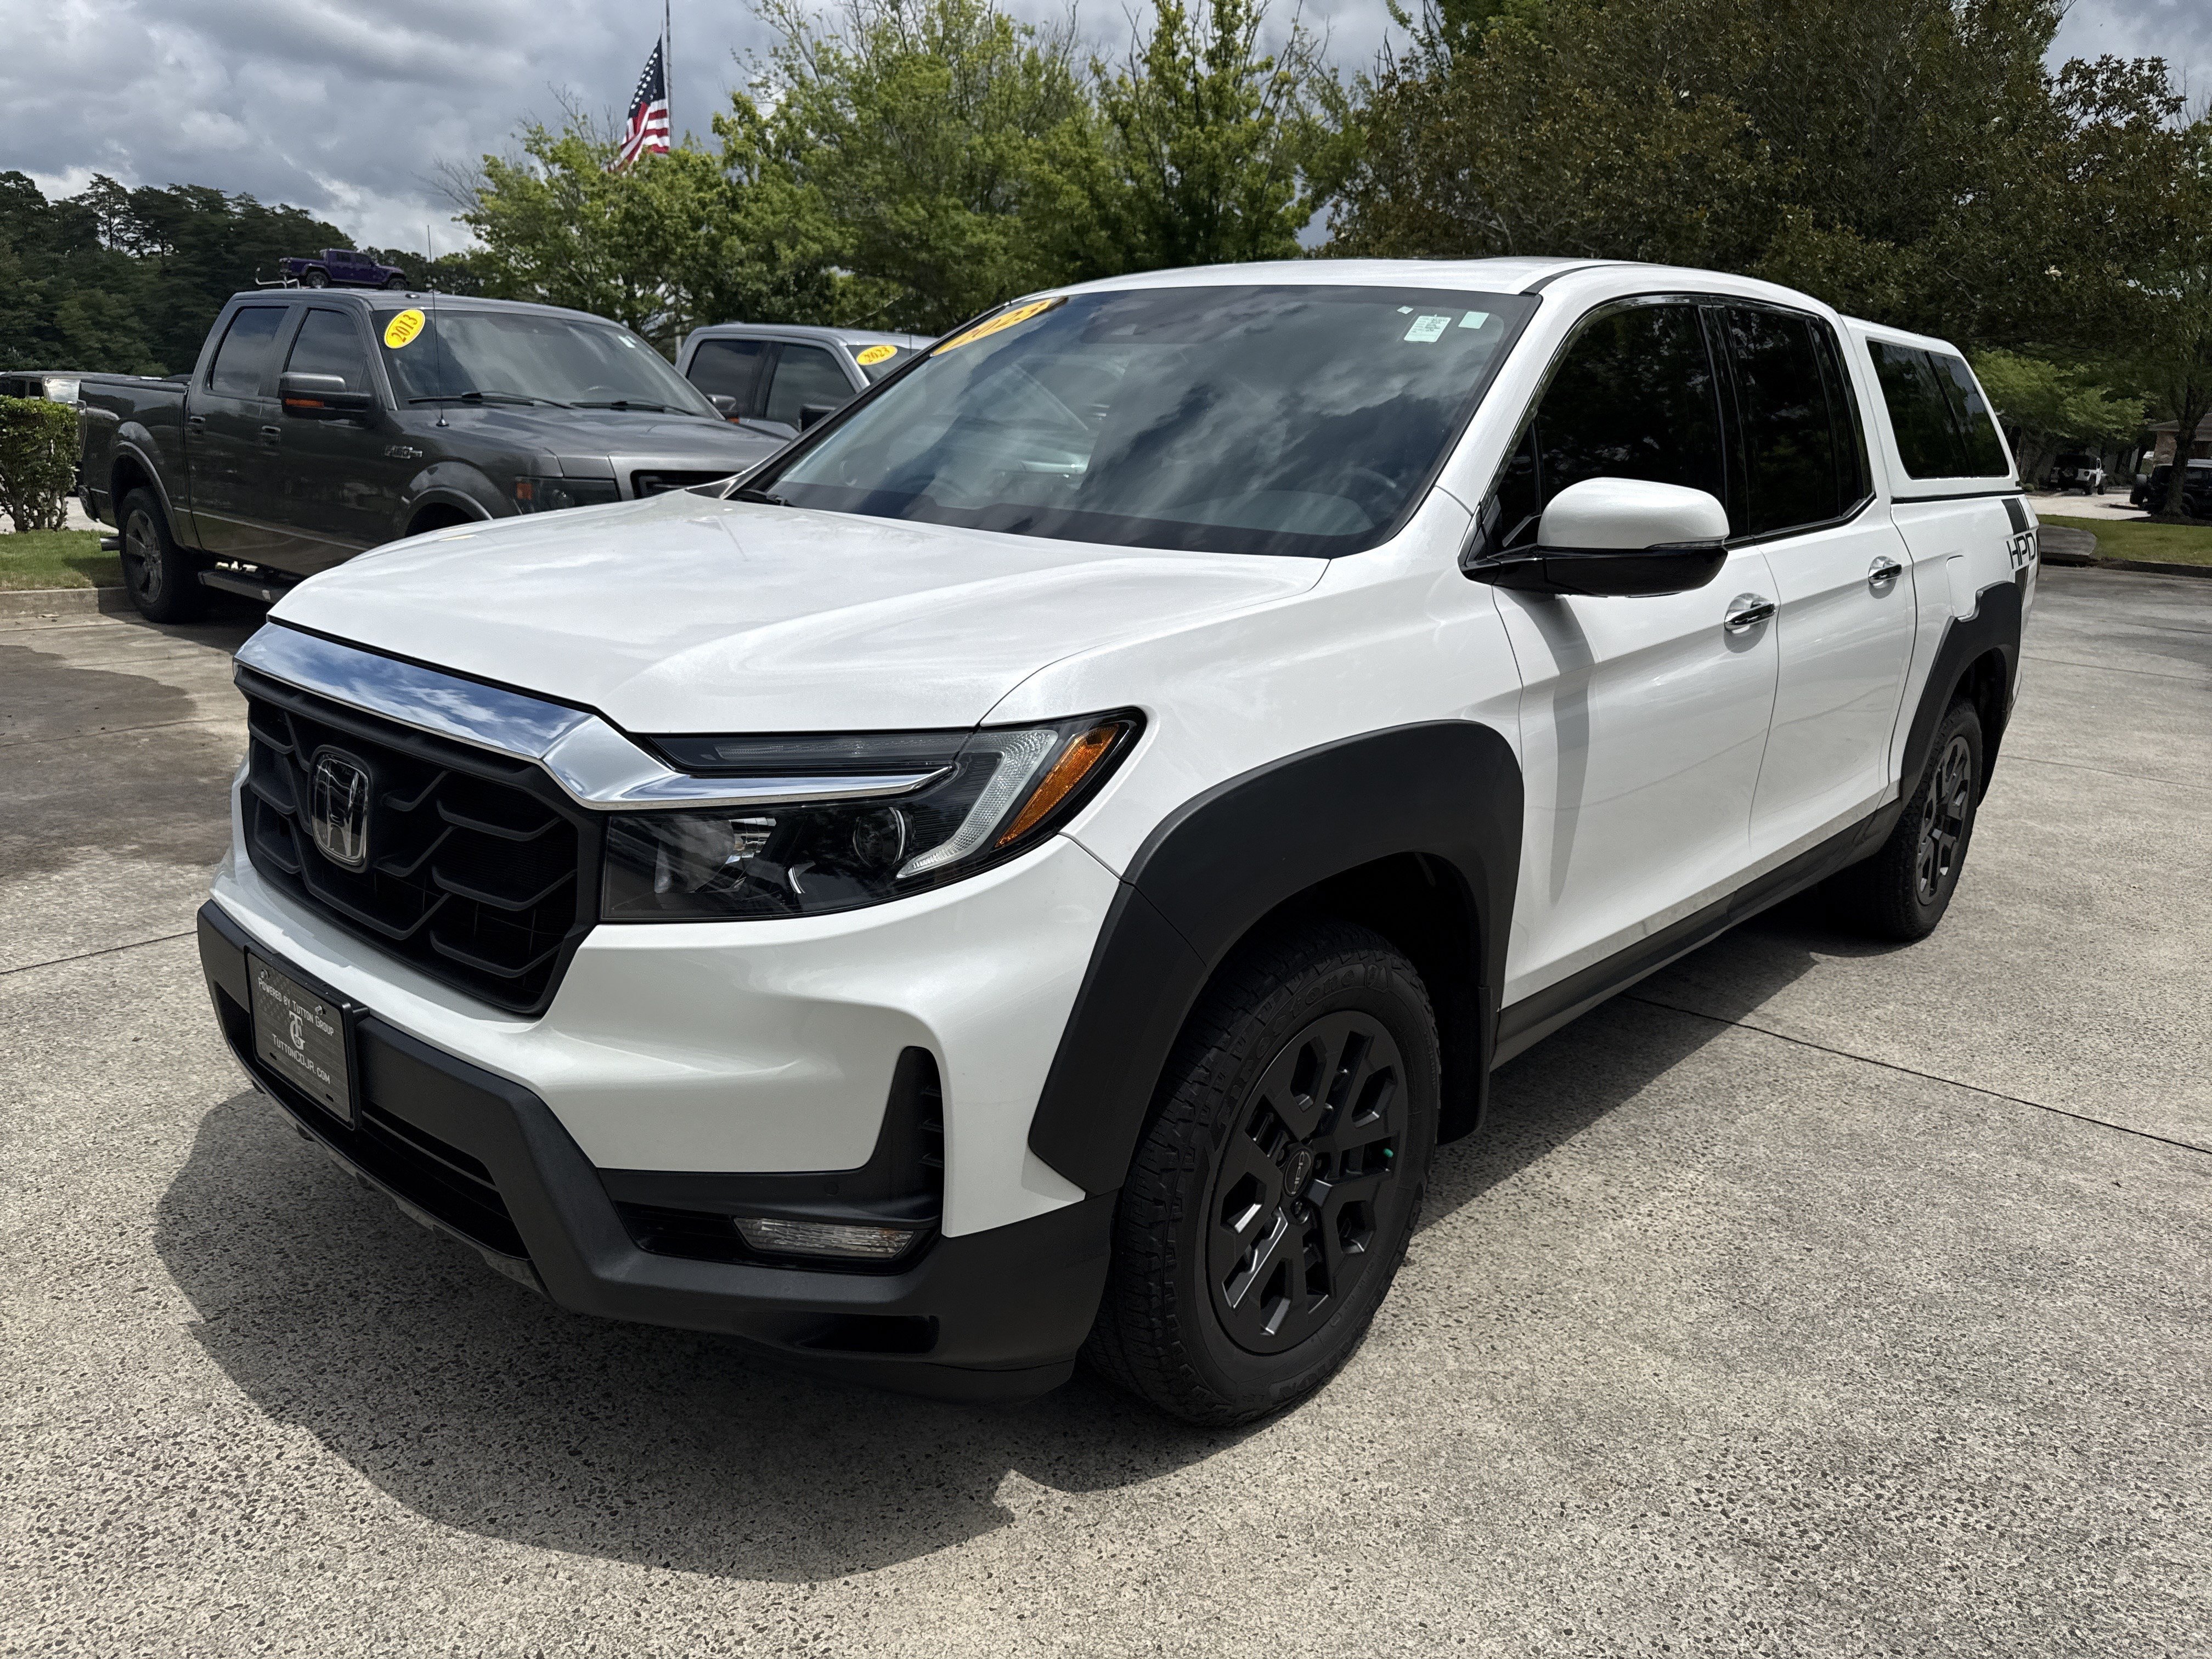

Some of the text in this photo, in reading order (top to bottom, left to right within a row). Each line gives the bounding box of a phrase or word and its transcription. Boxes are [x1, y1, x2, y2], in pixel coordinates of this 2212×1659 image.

[391, 314, 417, 342] 2013
[864, 347, 890, 363] 2023
[2006, 532, 2036, 569] HPD
